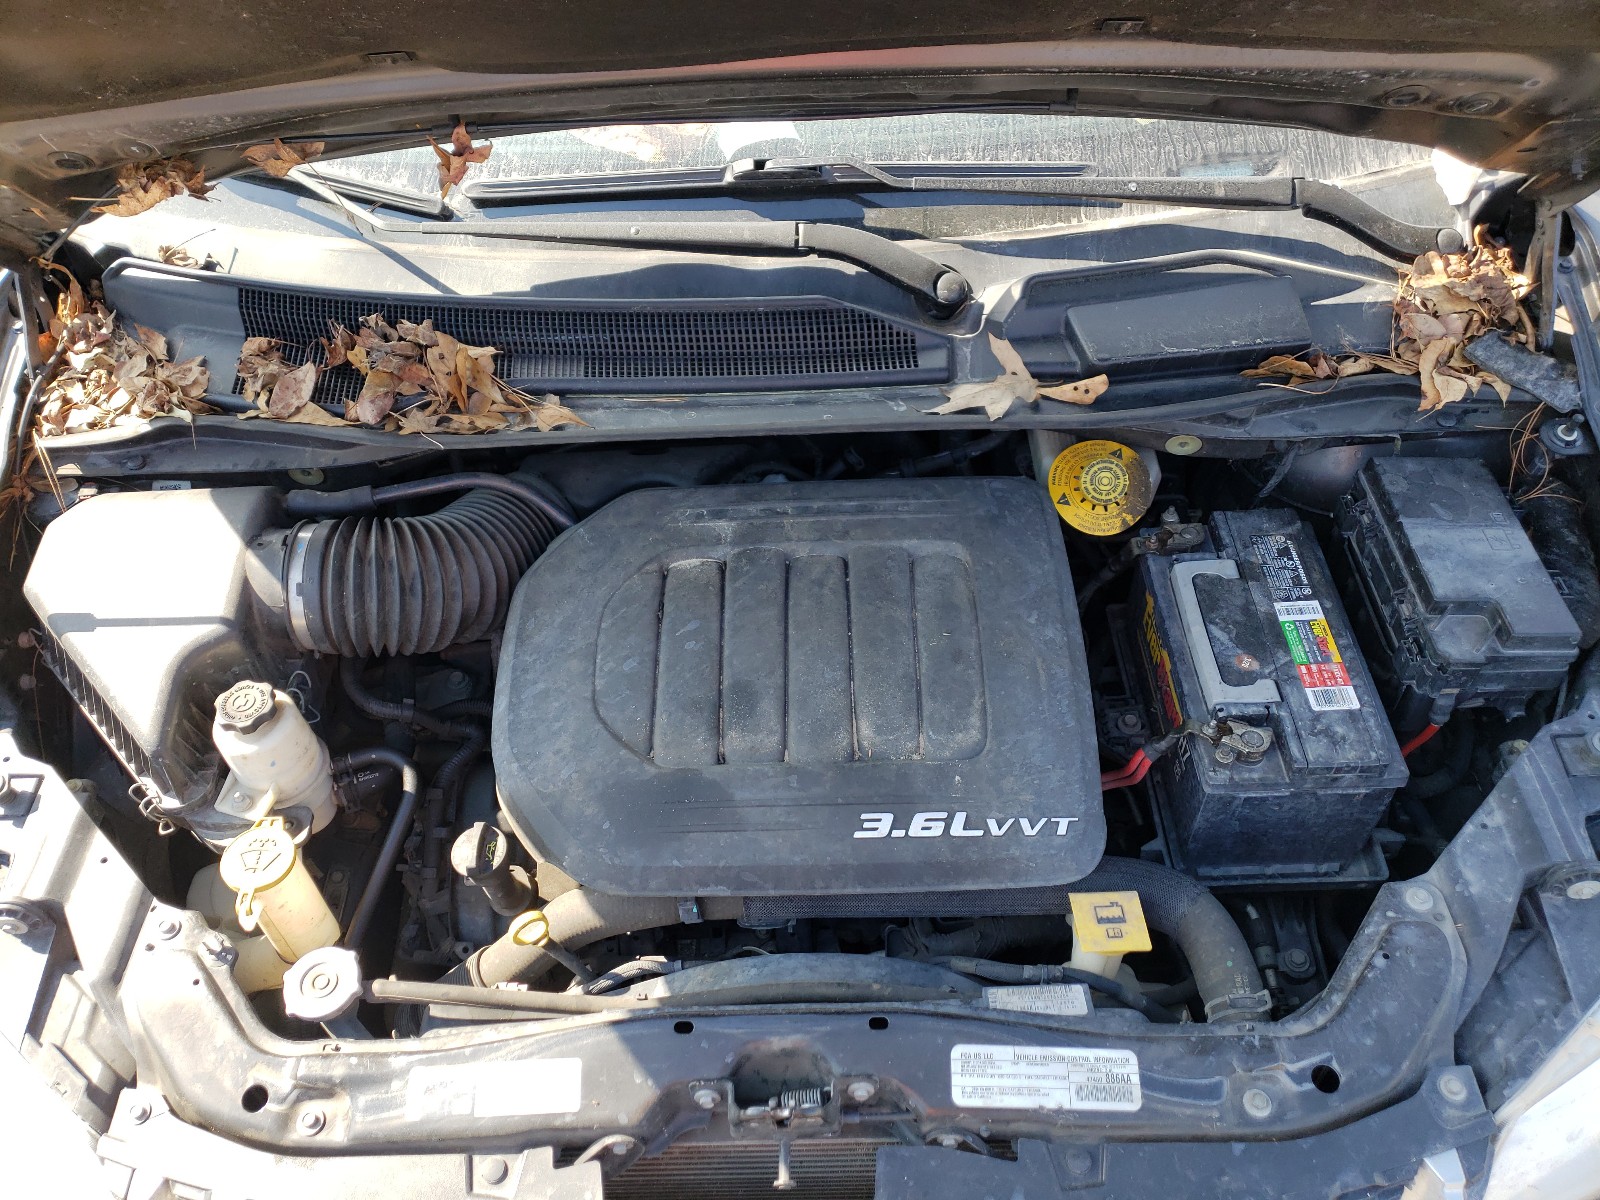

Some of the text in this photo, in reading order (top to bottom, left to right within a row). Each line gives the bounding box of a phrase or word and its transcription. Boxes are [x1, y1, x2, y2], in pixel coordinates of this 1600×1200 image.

[960, 1052, 972, 1060] FCA
[1039, 1054, 1066, 1062] EMISSION
[1094, 1056, 1130, 1064] INFORMATION
[1105, 1073, 1132, 1084] 886AA
